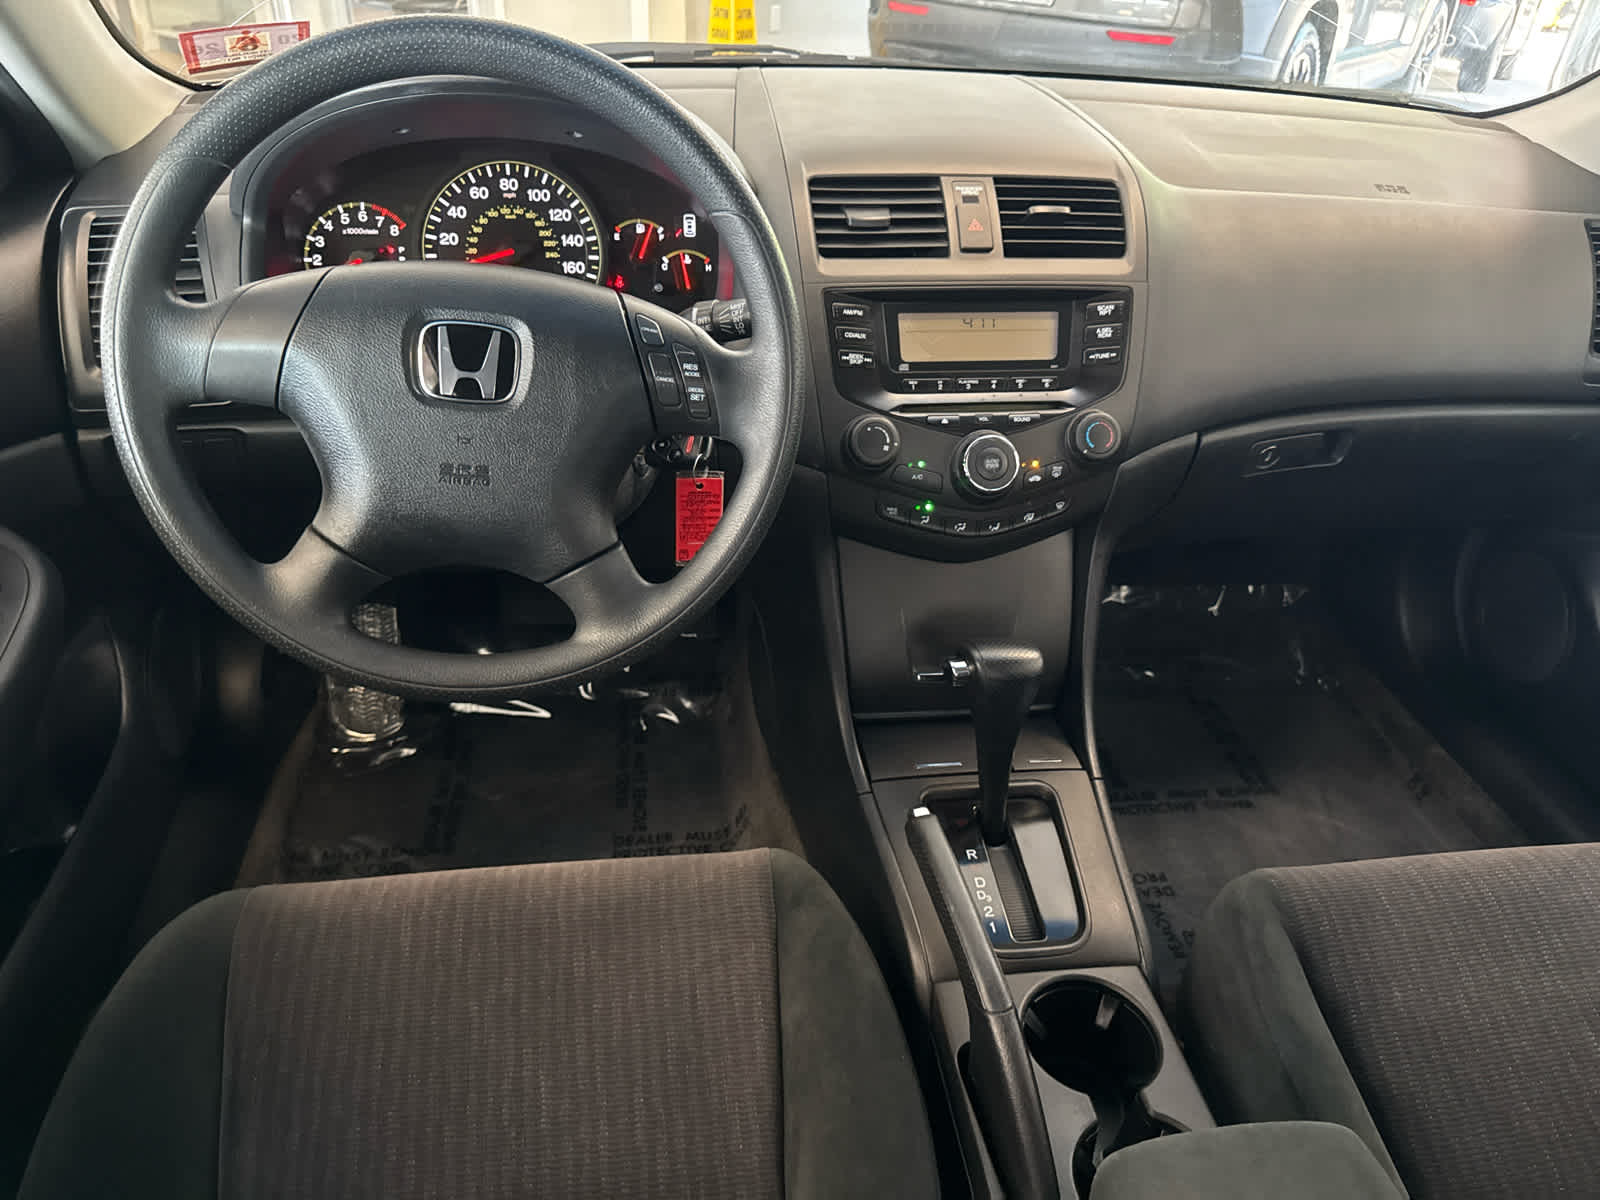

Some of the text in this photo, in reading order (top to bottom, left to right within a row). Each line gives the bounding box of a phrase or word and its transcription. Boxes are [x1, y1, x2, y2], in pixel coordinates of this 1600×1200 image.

[499, 178, 518, 191] 80
[469, 187, 489, 199] 60
[527, 189, 550, 201] 100
[340, 213, 350, 225] 5
[357, 210, 368, 222] 6
[447, 206, 467, 219] 40
[549, 209, 572, 222] 120
[323, 219, 334, 232] 4
[375, 215, 385, 228] 7
[389, 224, 400, 237] 8
[314, 234, 326, 248] 3
[439, 233, 459, 246] 20
[560, 234, 584, 248] 140
[312, 253, 323, 266] 2
[562, 261, 585, 275] 160
[682, 362, 699, 371] RES
[655, 375, 676, 384] CANCEL
[690, 393, 705, 401] SET
[911, 473, 924, 481] A/C
[965, 848, 979, 861] R
[973, 876, 987, 889] D
[983, 905, 996, 918] 2
[988, 920, 997, 934] 1
